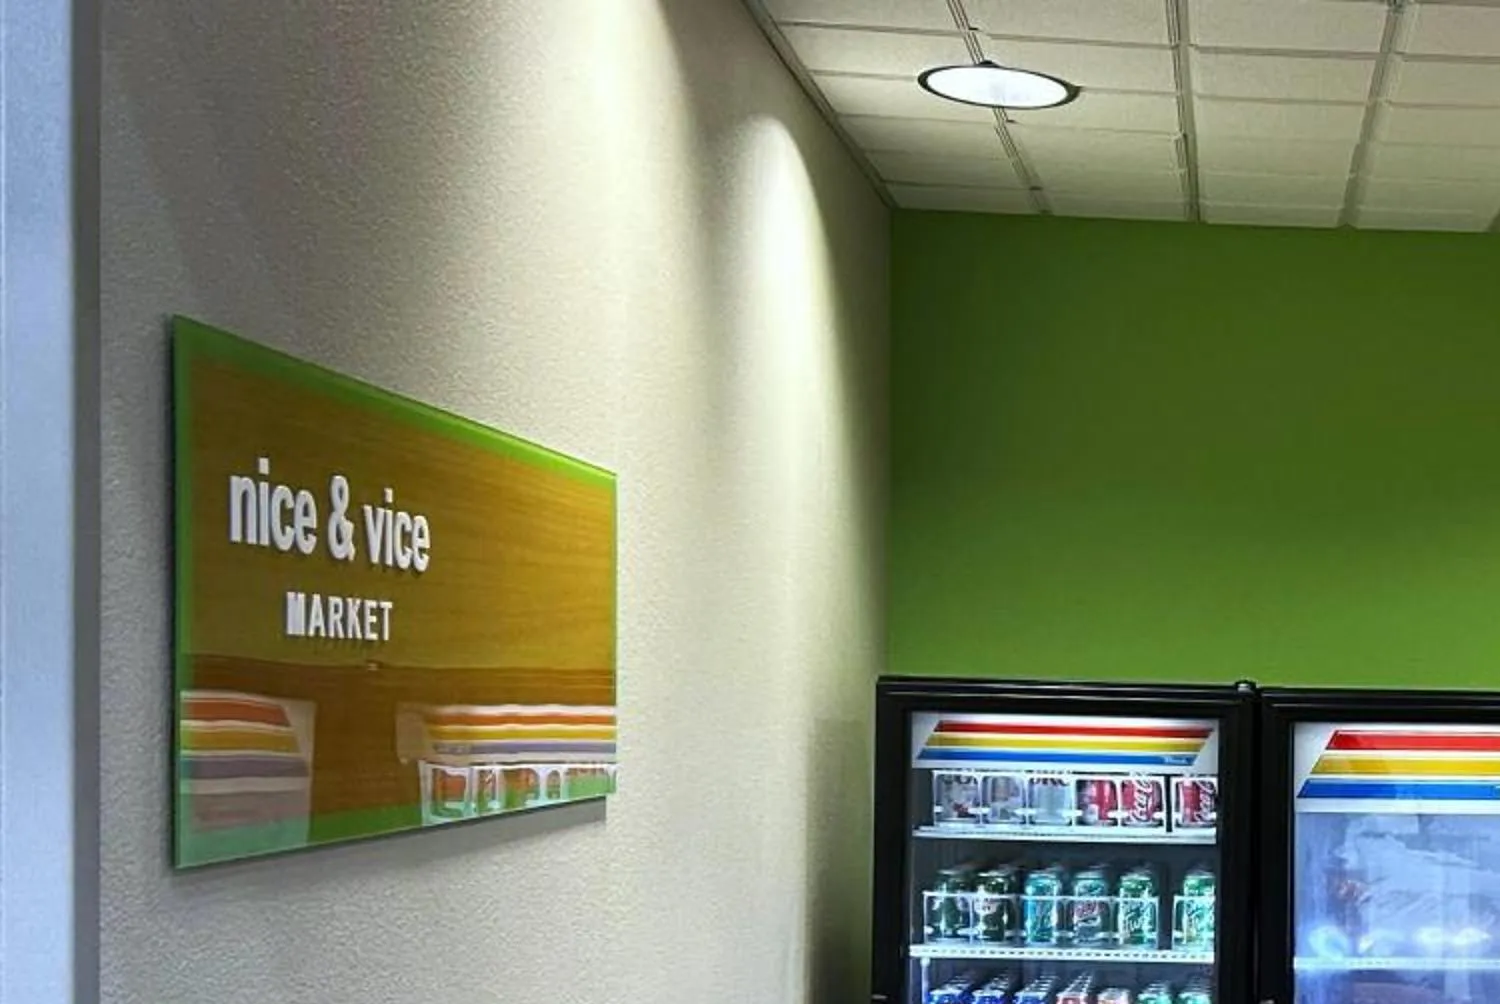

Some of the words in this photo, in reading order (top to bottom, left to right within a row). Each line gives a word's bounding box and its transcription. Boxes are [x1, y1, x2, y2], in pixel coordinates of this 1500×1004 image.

[229, 457, 317, 555] nice
[327, 474, 355, 560] &
[363, 488, 432, 572] vice
[285, 590, 394, 642] MARKET
